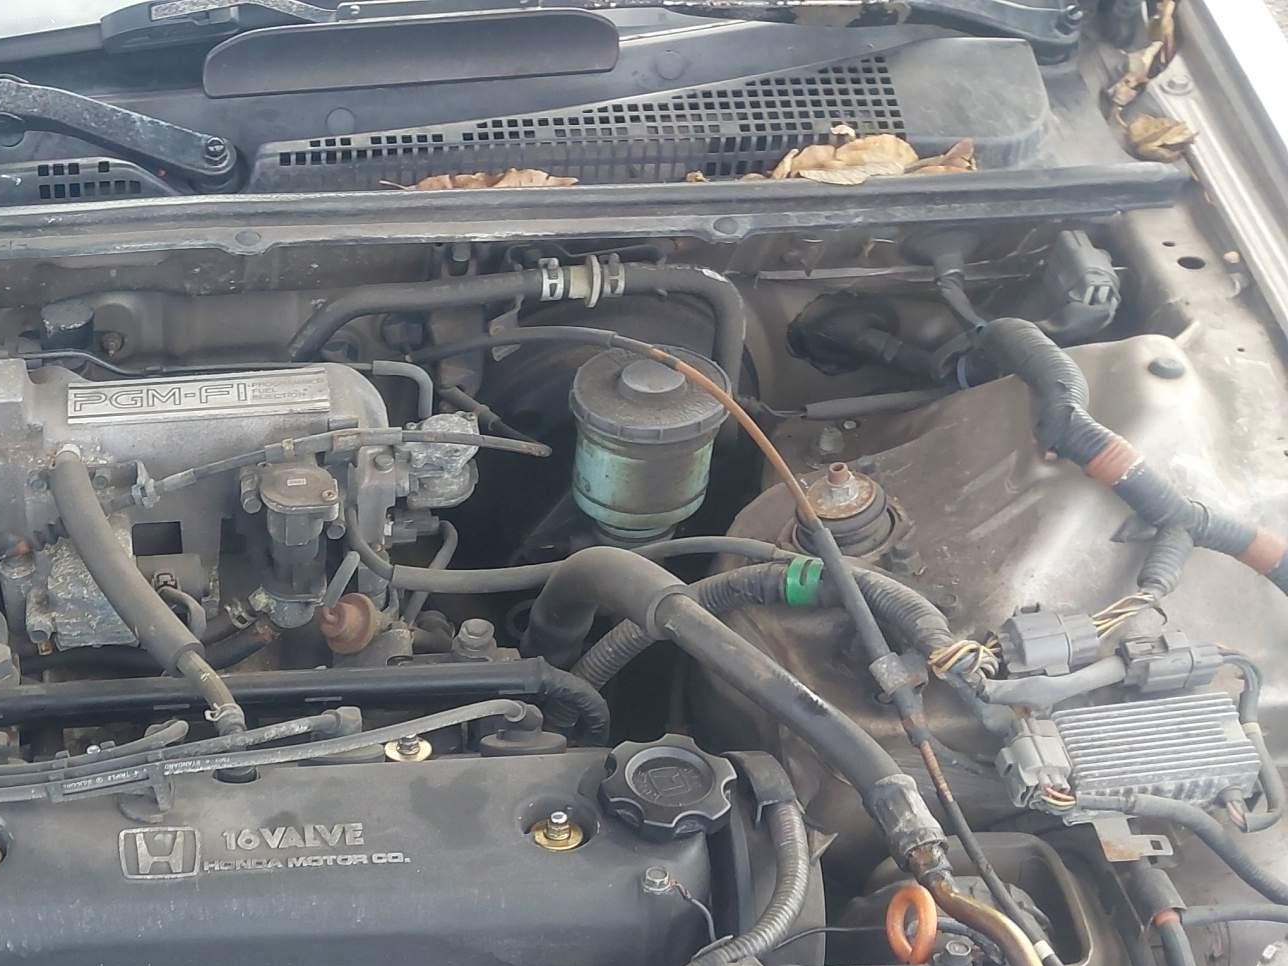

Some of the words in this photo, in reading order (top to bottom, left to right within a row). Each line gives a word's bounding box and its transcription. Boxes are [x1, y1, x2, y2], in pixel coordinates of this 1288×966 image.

[73, 382, 248, 412] PGM-FI
[203, 858, 282, 873] HONDA
[287, 854, 368, 868] MOTOR
[372, 852, 412, 864] CO.
